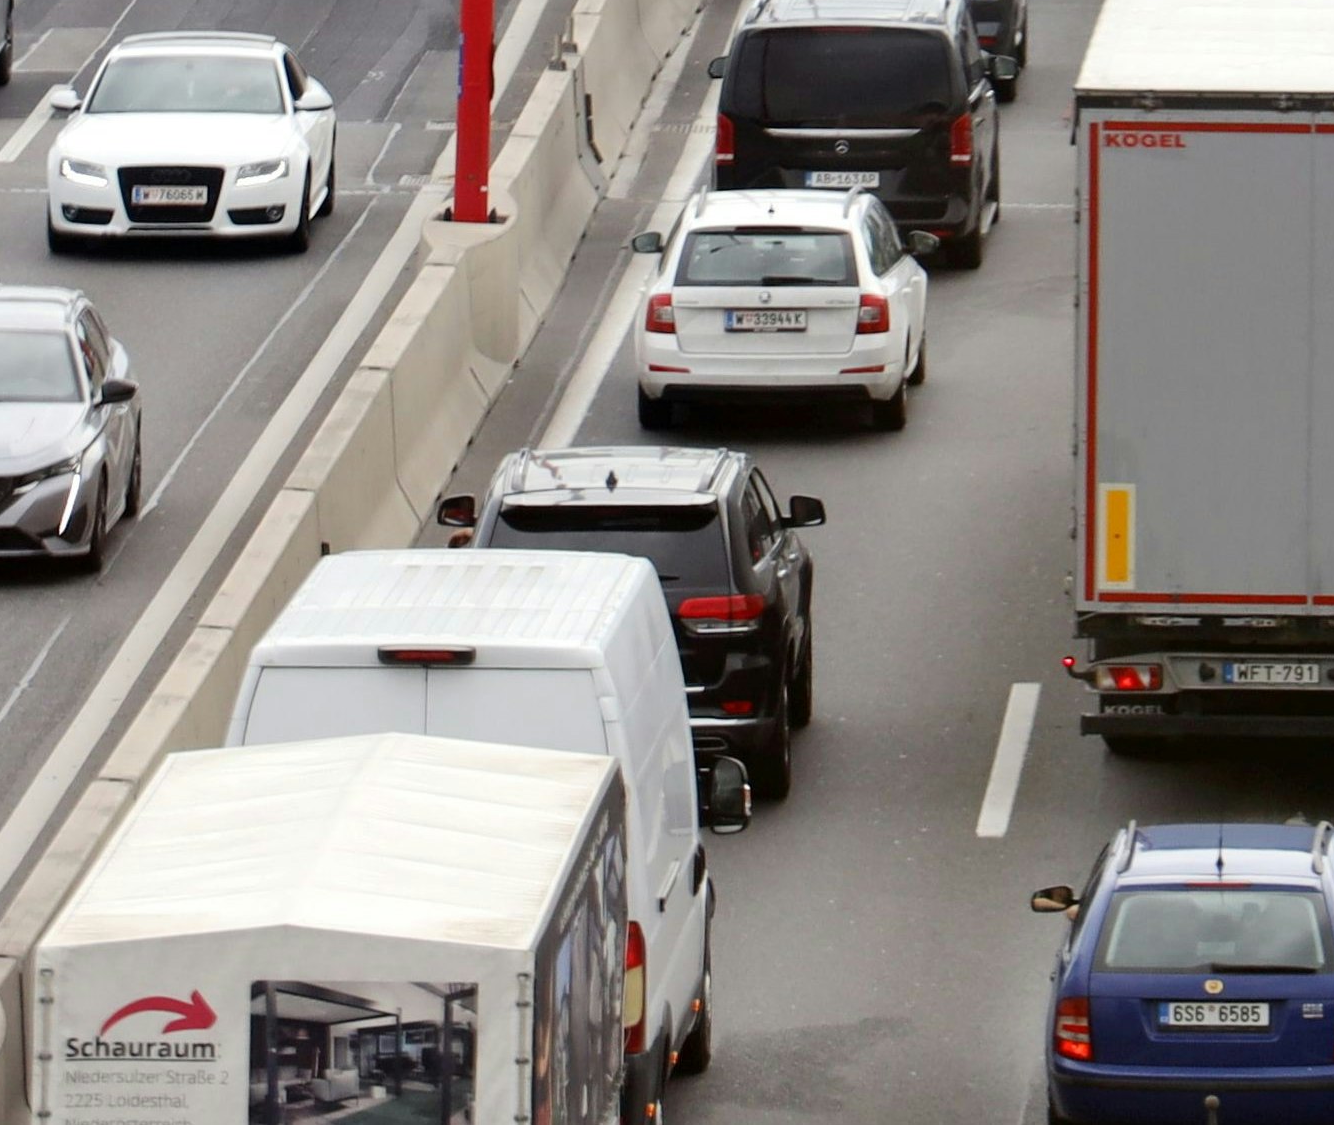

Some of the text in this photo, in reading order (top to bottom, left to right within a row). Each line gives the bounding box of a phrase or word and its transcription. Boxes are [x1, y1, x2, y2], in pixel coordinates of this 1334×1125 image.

[1238, 665, 1315, 682] WFT-791
[1218, 1005, 1261, 1023] 6585
[166, 1070, 216, 1085] Straße
[219, 1071, 230, 1085] 2
[64, 1093, 104, 1108] 2225
